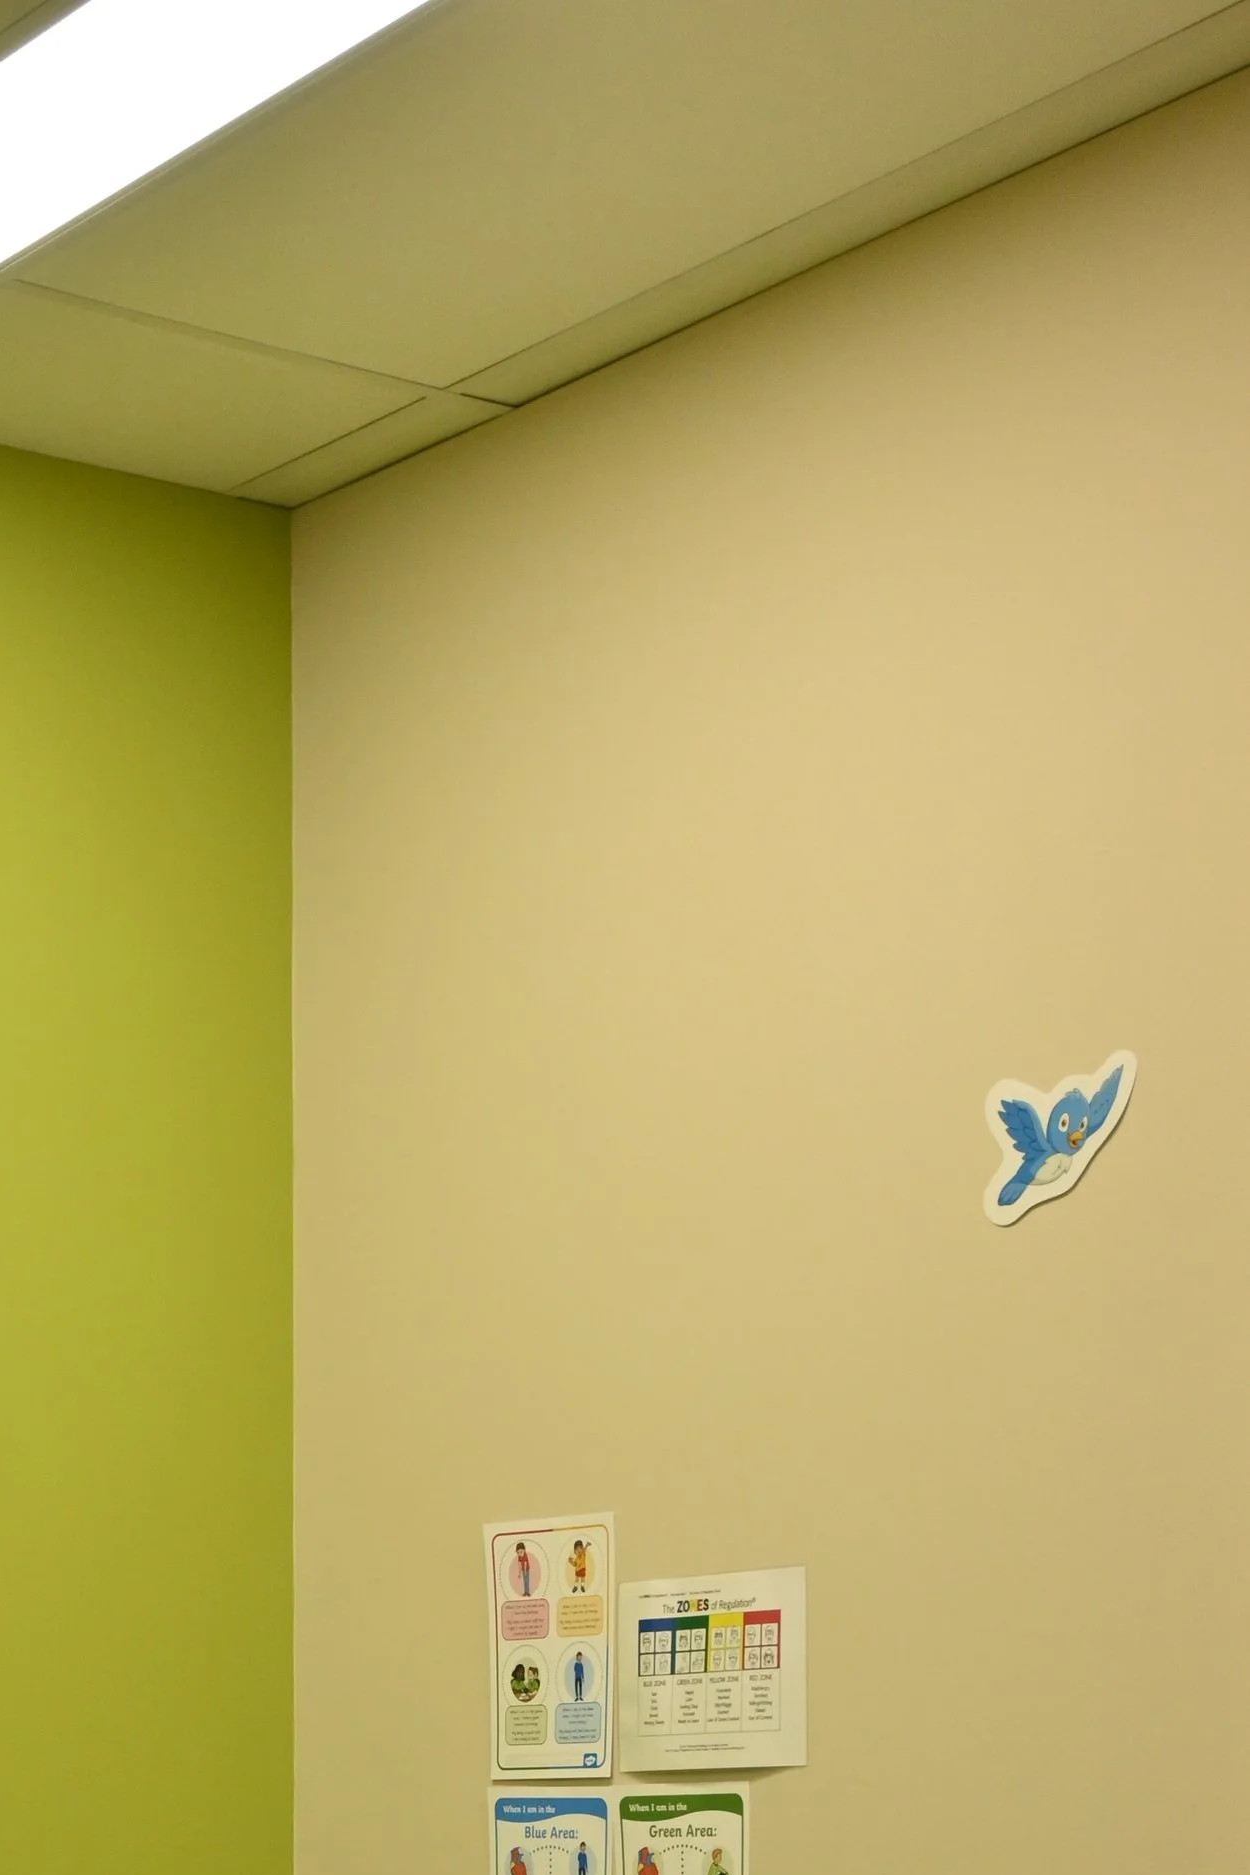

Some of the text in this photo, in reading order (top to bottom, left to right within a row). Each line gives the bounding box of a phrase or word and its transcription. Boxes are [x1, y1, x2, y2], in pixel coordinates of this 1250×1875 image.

[662, 1604, 675, 1614] The
[676, 1598, 709, 1613] ZONES
[711, 1601, 718, 1610] of
[502, 1805, 521, 1813] When
[538, 1805, 544, 1813] in
[545, 1804, 556, 1813] the
[629, 1803, 649, 1812] When
[668, 1802, 675, 1811] in
[676, 1802, 687, 1811] the
[524, 1825, 578, 1839] Blue Area:
[649, 1823, 717, 1838] Green Area:
